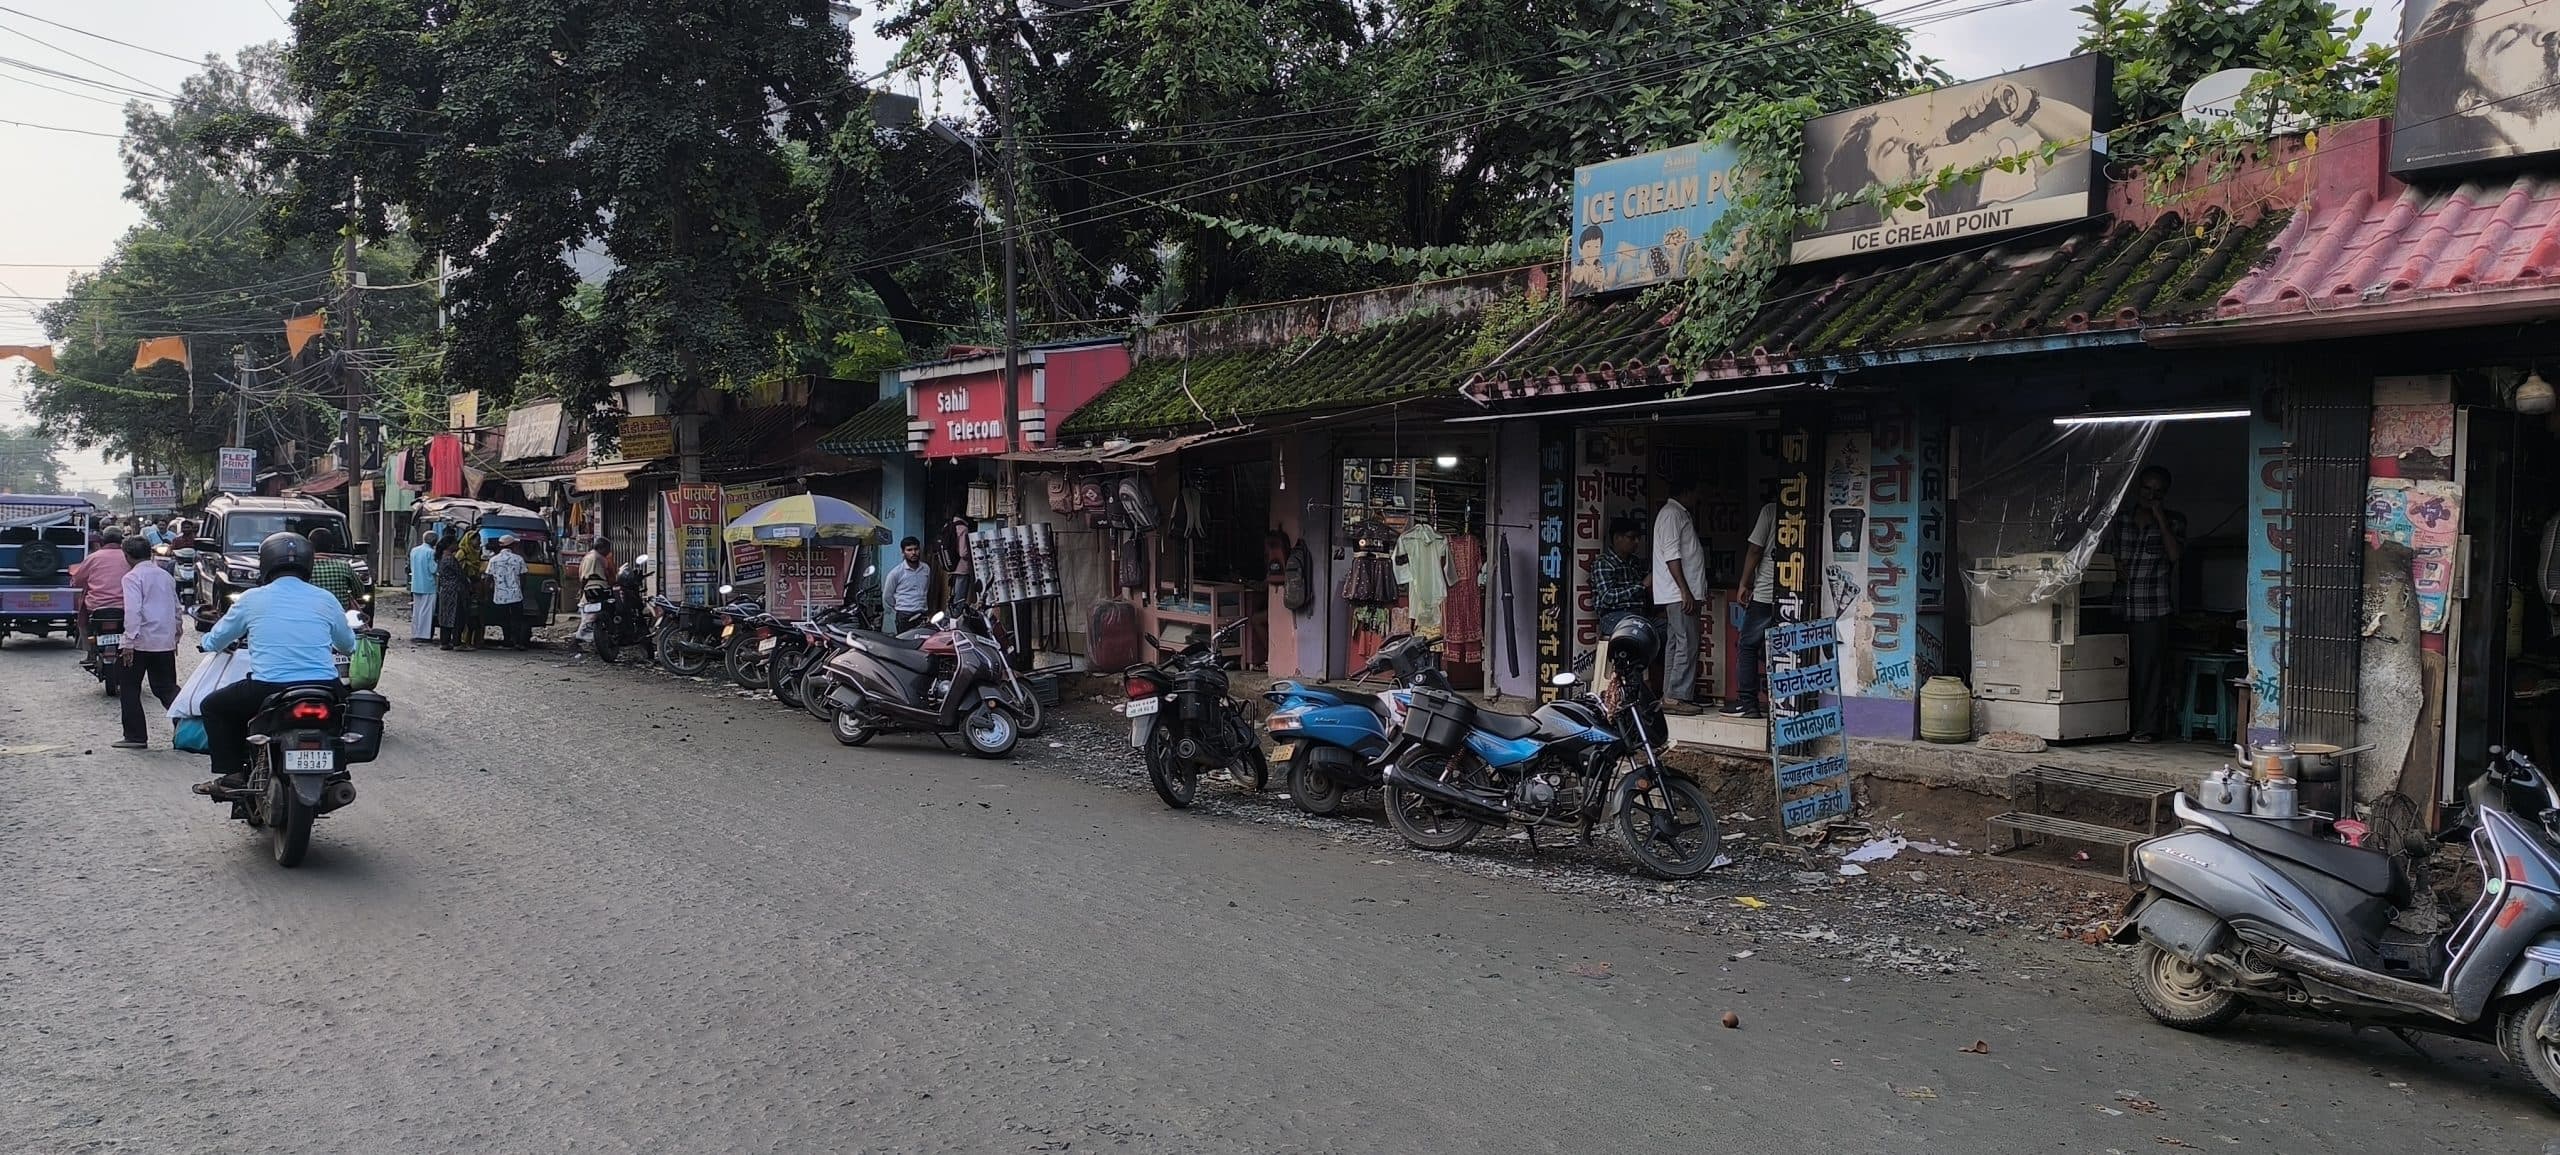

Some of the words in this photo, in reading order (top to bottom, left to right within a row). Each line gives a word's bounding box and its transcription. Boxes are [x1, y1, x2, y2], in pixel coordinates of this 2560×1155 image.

[1582, 191, 1616, 226] ICE
[1622, 176, 1700, 219] CREAM
[1852, 231, 1880, 251] ICE
[1885, 219, 1950, 245] CREAM
[1956, 207, 2014, 234] POINT
[937, 386, 968, 413] Sahil
[947, 418, 1002, 441] Telecom
[222, 453, 250, 461] FLEX
[135, 481, 167, 490] FLEX
[143, 489, 175, 497] PRINT
[777, 562, 837, 576] Telecom
[1773, 669, 1804, 694] फोटो
